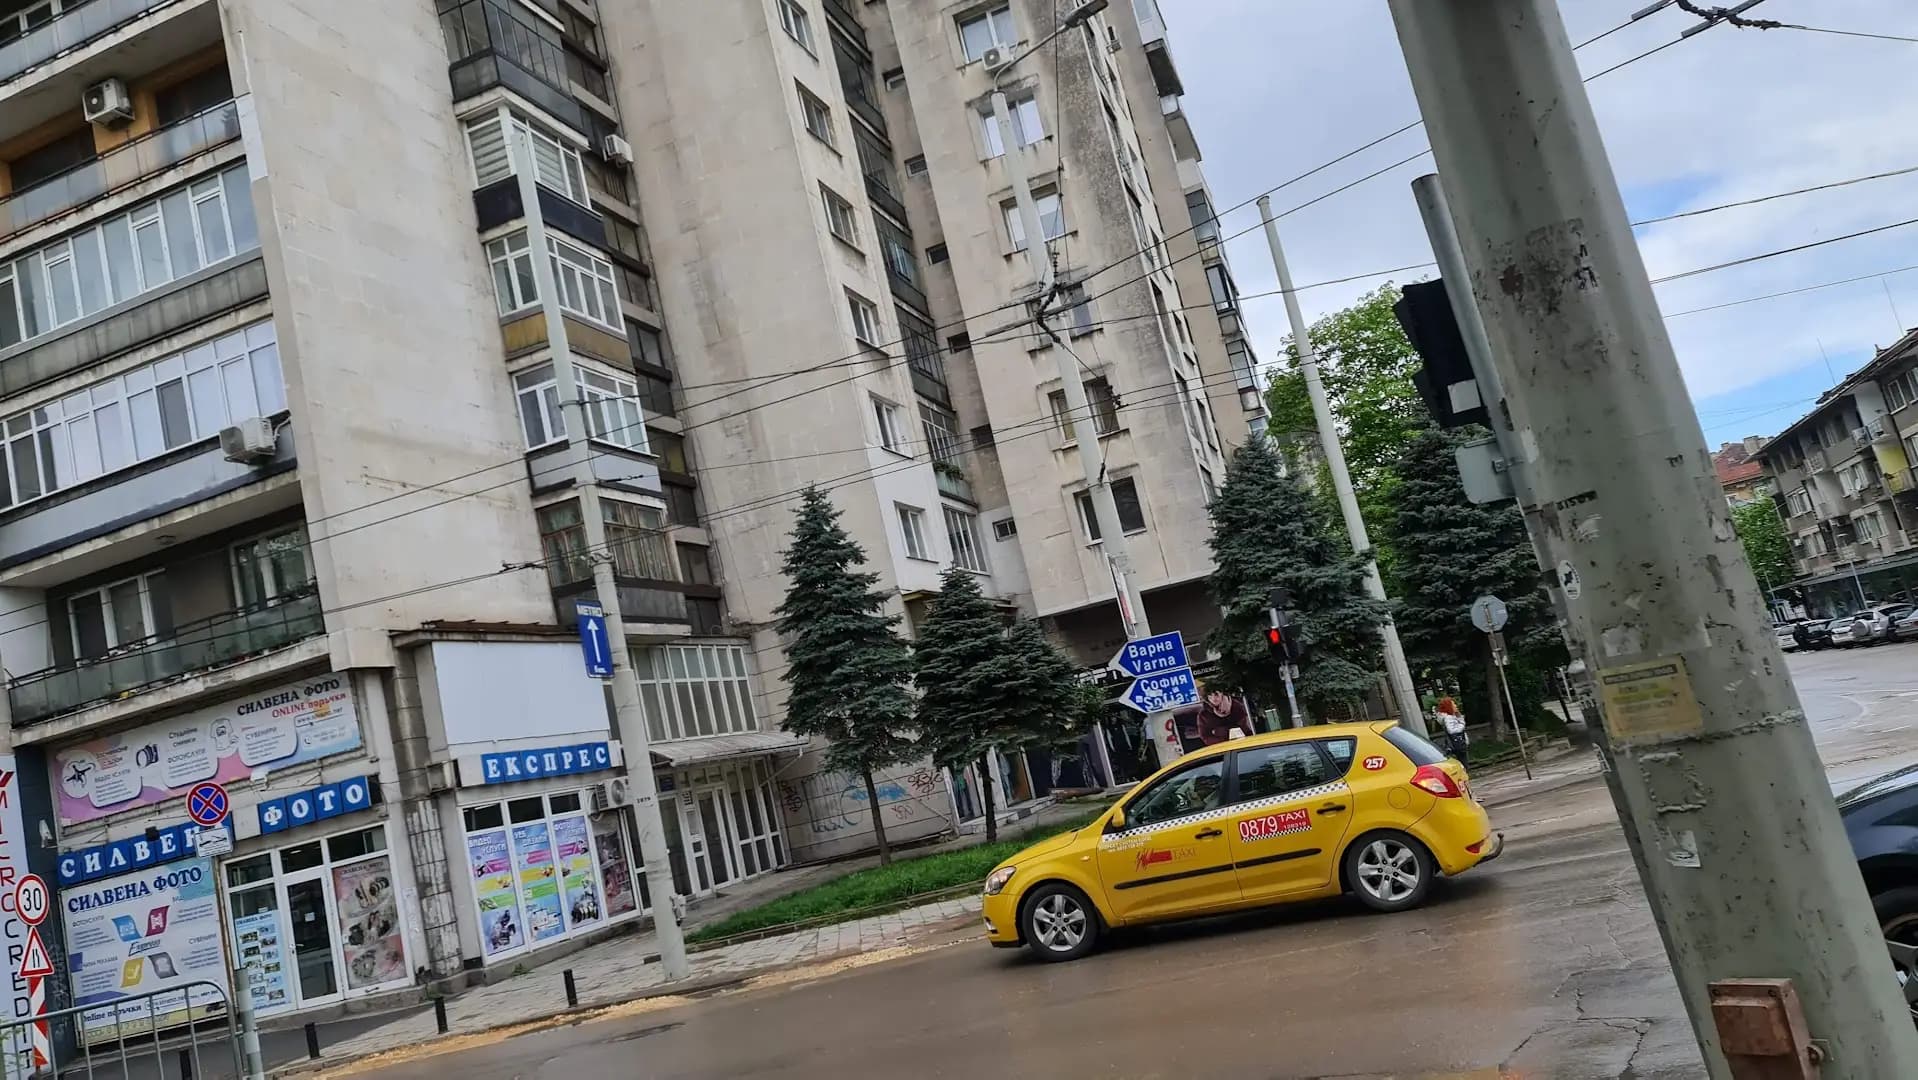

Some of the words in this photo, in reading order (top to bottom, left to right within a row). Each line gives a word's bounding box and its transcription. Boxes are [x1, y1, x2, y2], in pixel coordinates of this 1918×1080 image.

[1128, 640, 1173, 659] Варна
[1132, 655, 1176, 673] Varna
[304, 678, 340, 697] ФОТО
[1140, 674, 1188, 691] София
[272, 703, 306, 718] ONLINE
[1143, 692, 1185, 710] Sofia
[486, 747, 607, 778] ЕКСПРЕС
[1365, 758, 1385, 769] 257
[61, 822, 222, 878] СИЛВЕН
[264, 784, 364, 826] ФОТО
[1240, 816, 1278, 838] 0879
[1278, 810, 1306, 822] TAXI
[22, 887, 42, 912] 30
[68, 880, 151, 913] СИЛВЕНА
[153, 867, 202, 891] ФОТО
